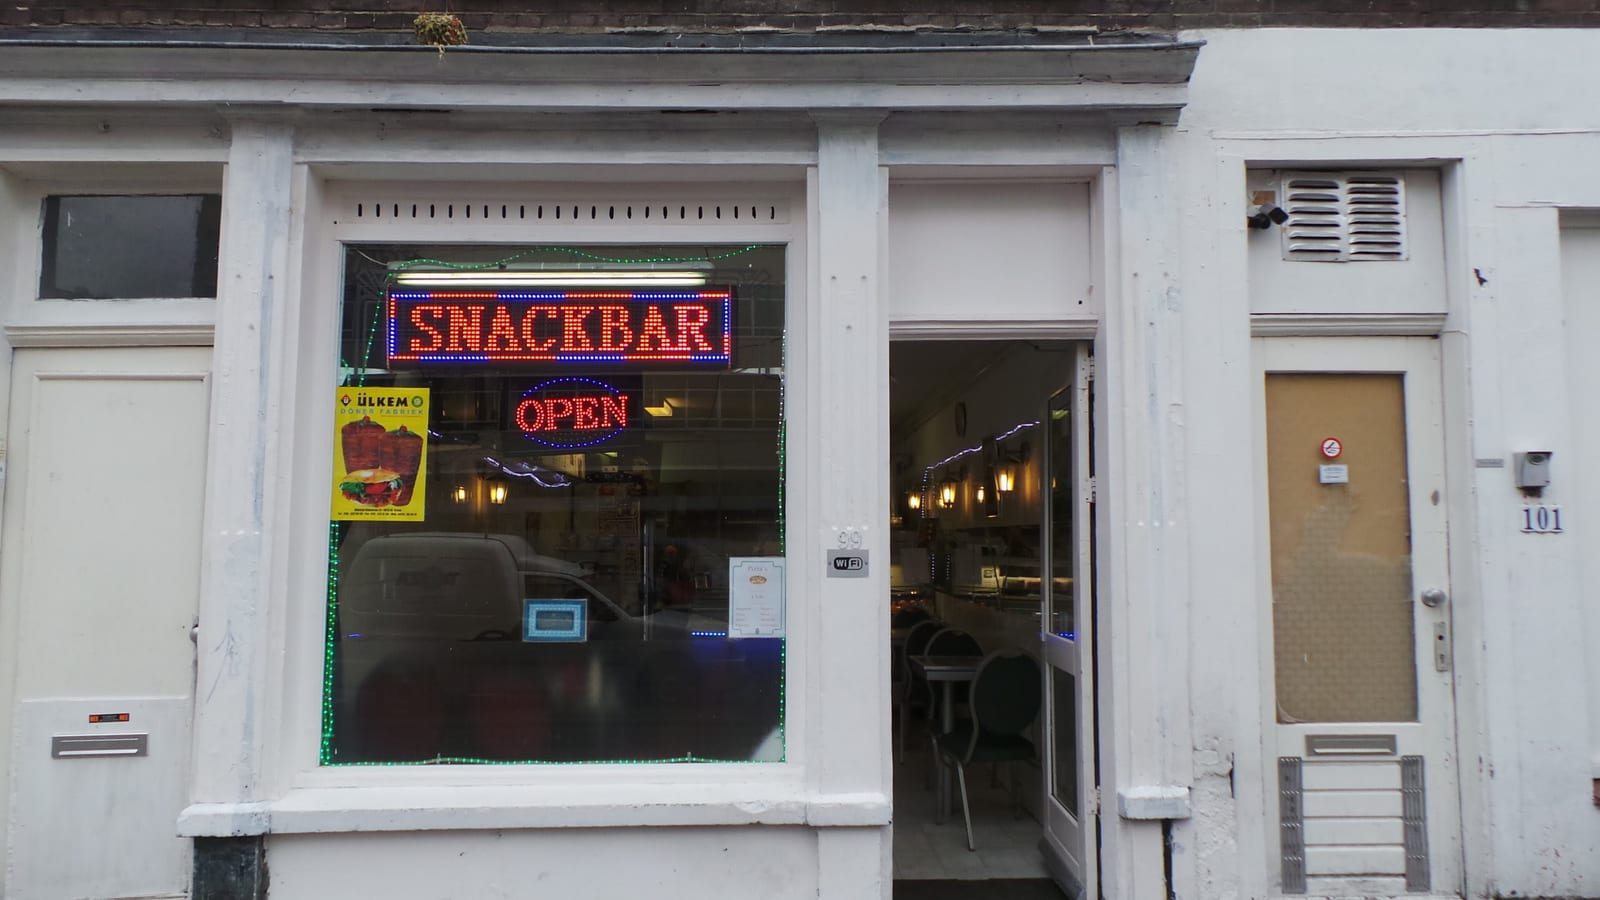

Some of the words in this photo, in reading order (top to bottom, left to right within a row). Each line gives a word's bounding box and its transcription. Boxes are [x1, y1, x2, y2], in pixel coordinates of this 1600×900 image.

[410, 306, 712, 351] SNACKBAR
[357, 392, 408, 407] ÜLKEM
[515, 395, 628, 432] OPEN
[1521, 505, 1563, 531] 101
[838, 530, 862, 550] 99
